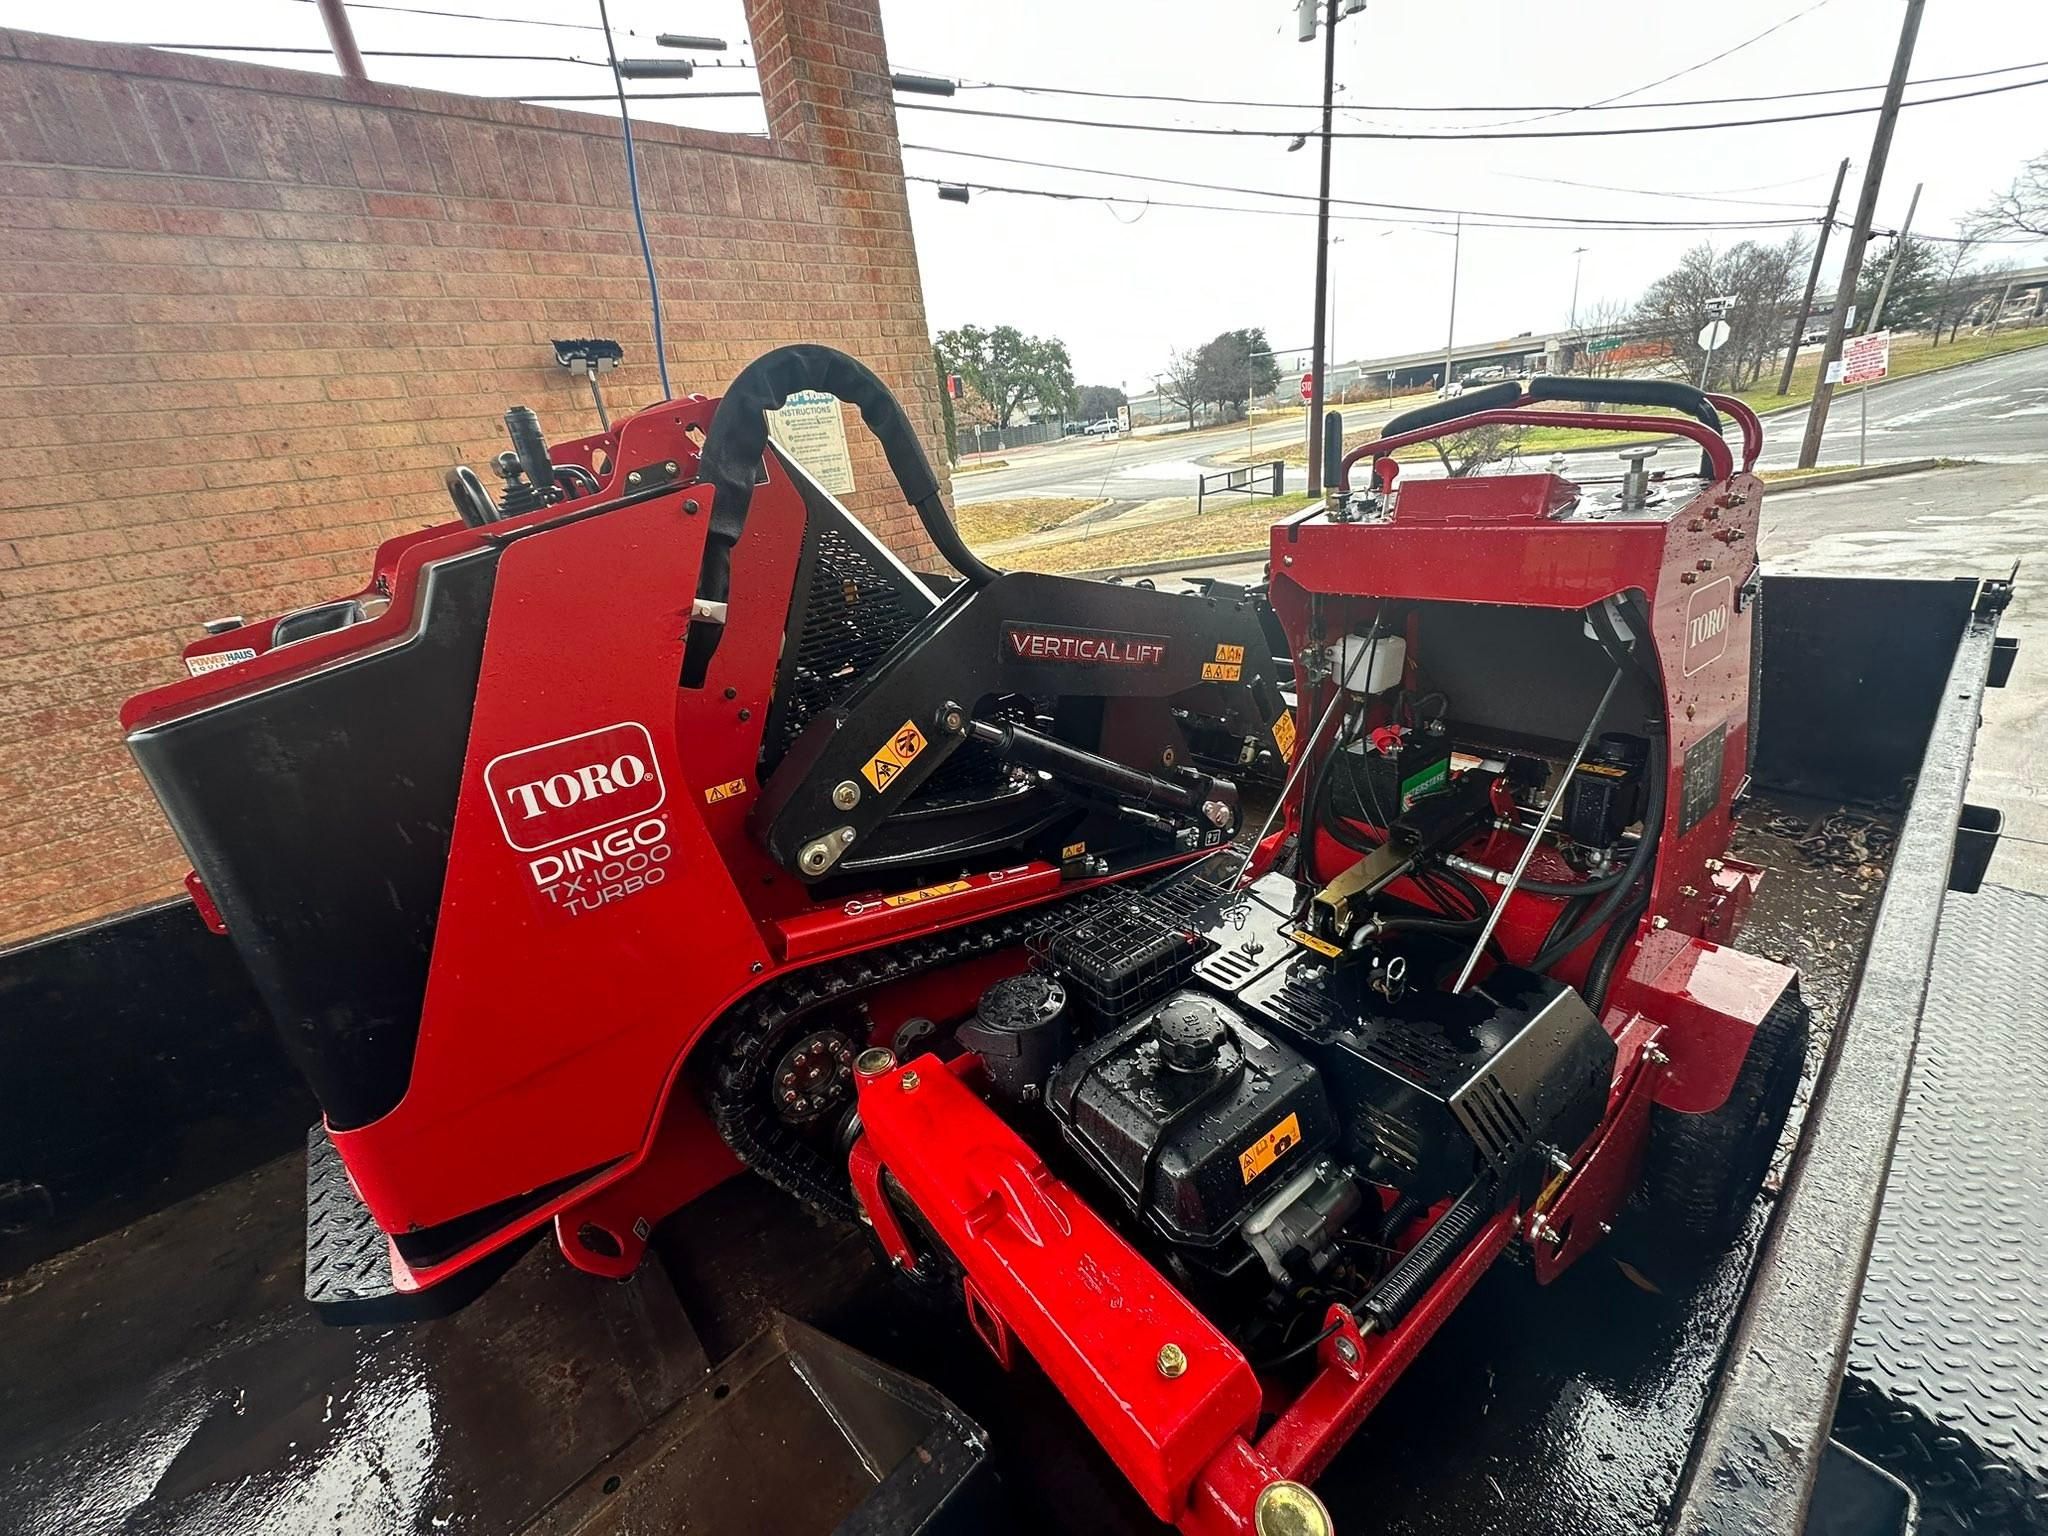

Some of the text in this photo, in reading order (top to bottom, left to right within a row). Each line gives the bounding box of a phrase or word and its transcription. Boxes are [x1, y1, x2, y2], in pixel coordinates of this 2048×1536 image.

[1301, 381, 1312, 392] STO
[780, 405, 831, 417] INSTRUCTIONS
[1690, 603, 1727, 649] TORO
[189, 649, 254, 667] POWERHAUS
[1012, 633, 1163, 662] VERTICAL LIFT
[192, 660, 241, 673] EQUIPM
[529, 818, 666, 886] DINGO
[562, 867, 666, 916] TURBO
